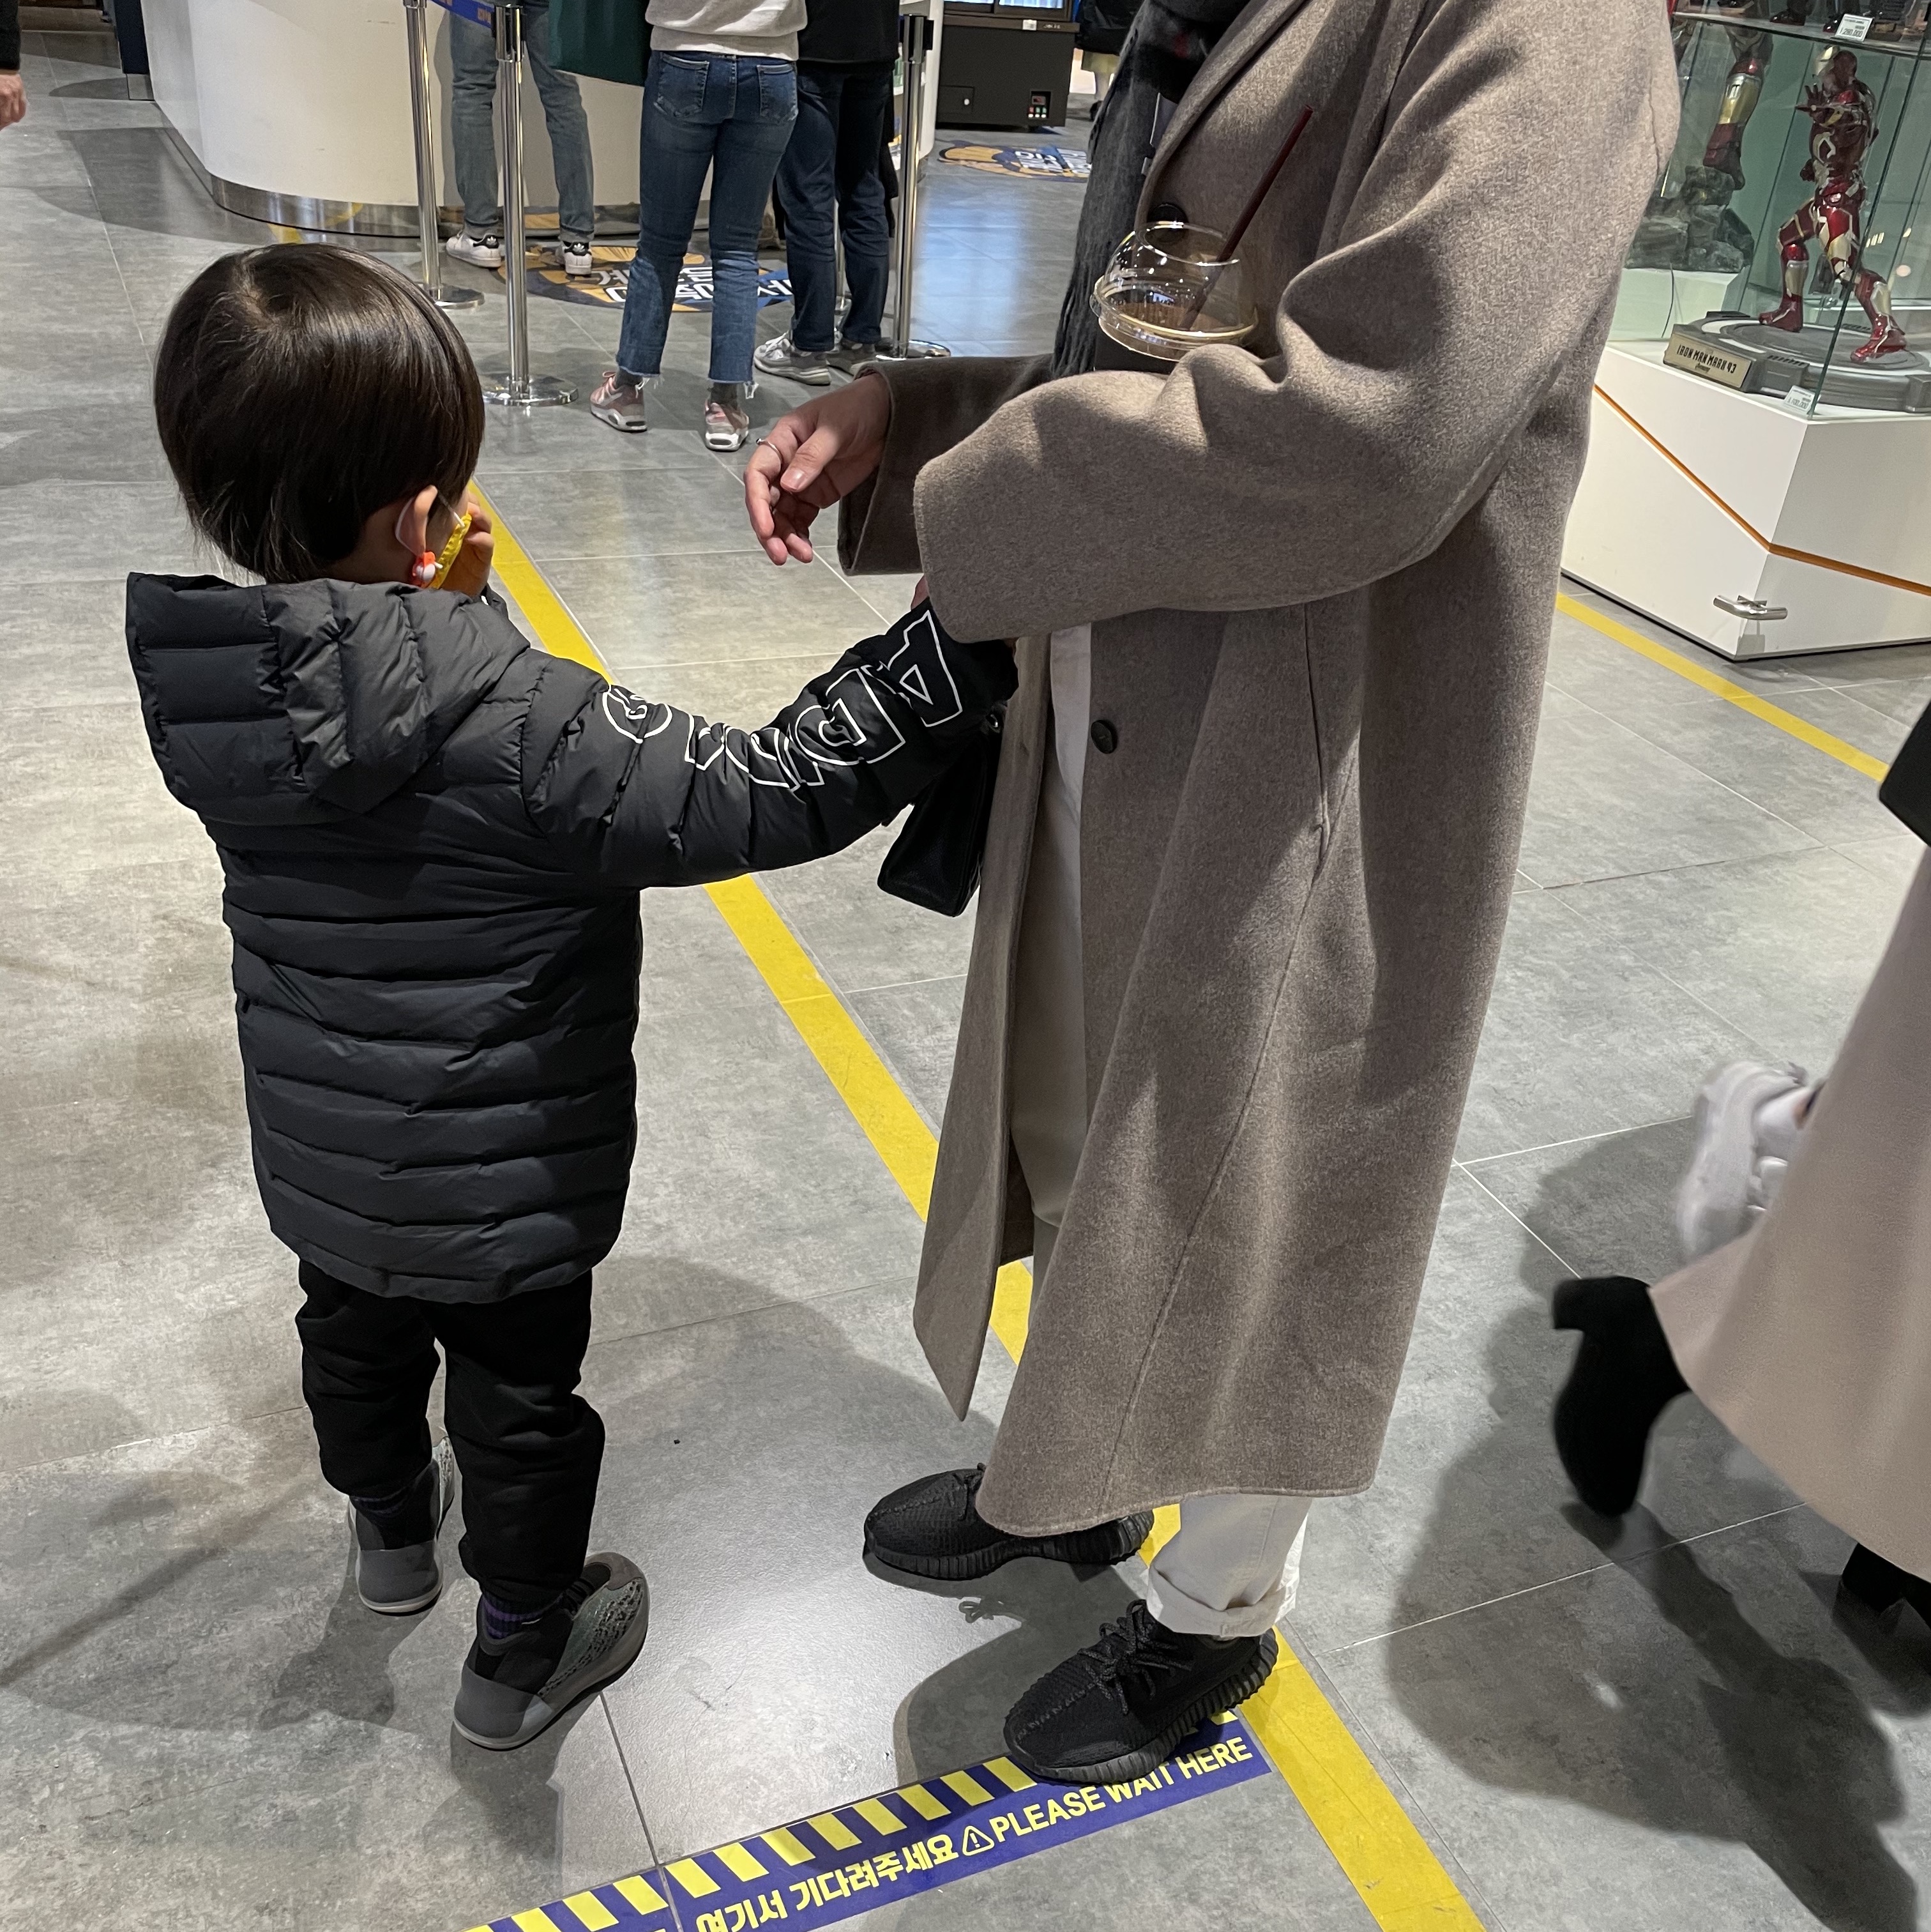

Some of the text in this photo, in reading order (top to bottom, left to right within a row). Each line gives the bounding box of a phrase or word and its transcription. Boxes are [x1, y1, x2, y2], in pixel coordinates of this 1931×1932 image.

[1677, 344, 1694, 358] IRON
[1692, 350, 1708, 364] MAN
[988, 1737, 1253, 1842] PLEASE WAIT HERE
[695, 1834, 959, 1932] 여기서 기다려주세요
